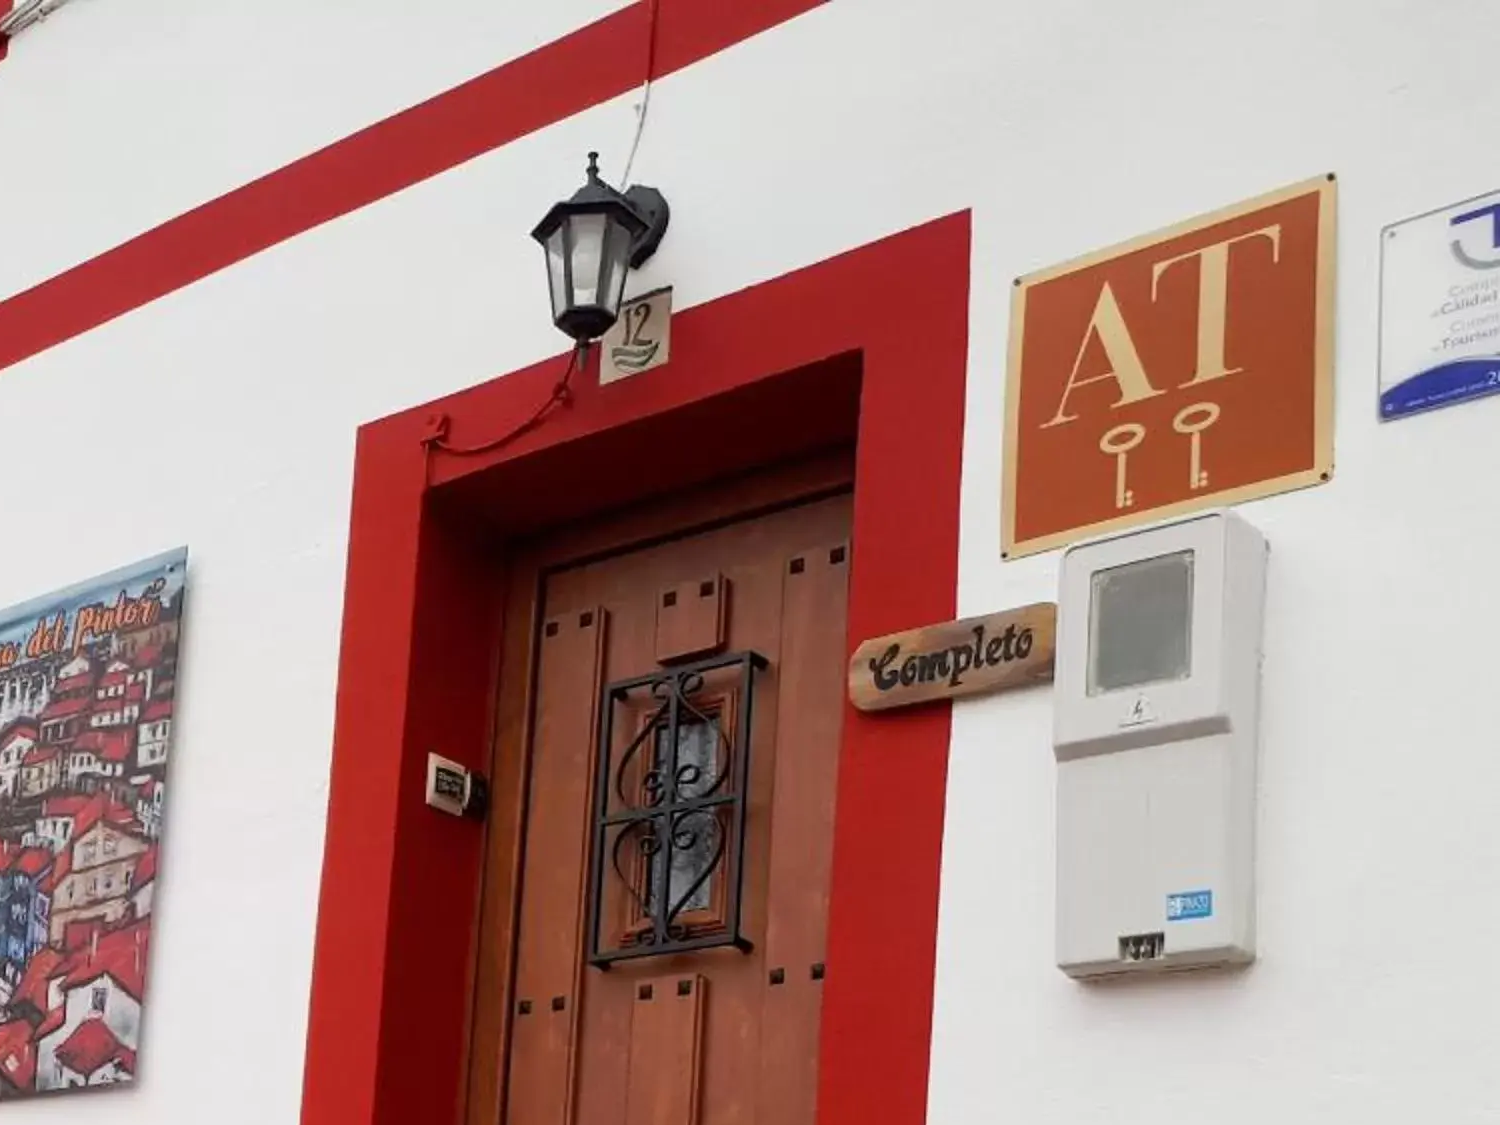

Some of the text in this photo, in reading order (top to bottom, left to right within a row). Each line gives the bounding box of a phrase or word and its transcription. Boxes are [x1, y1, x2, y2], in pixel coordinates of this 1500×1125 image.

[622, 303, 653, 346] 12
[1039, 223, 1282, 429] AT
[26, 608, 65, 658] del
[868, 623, 1034, 691] Completo
